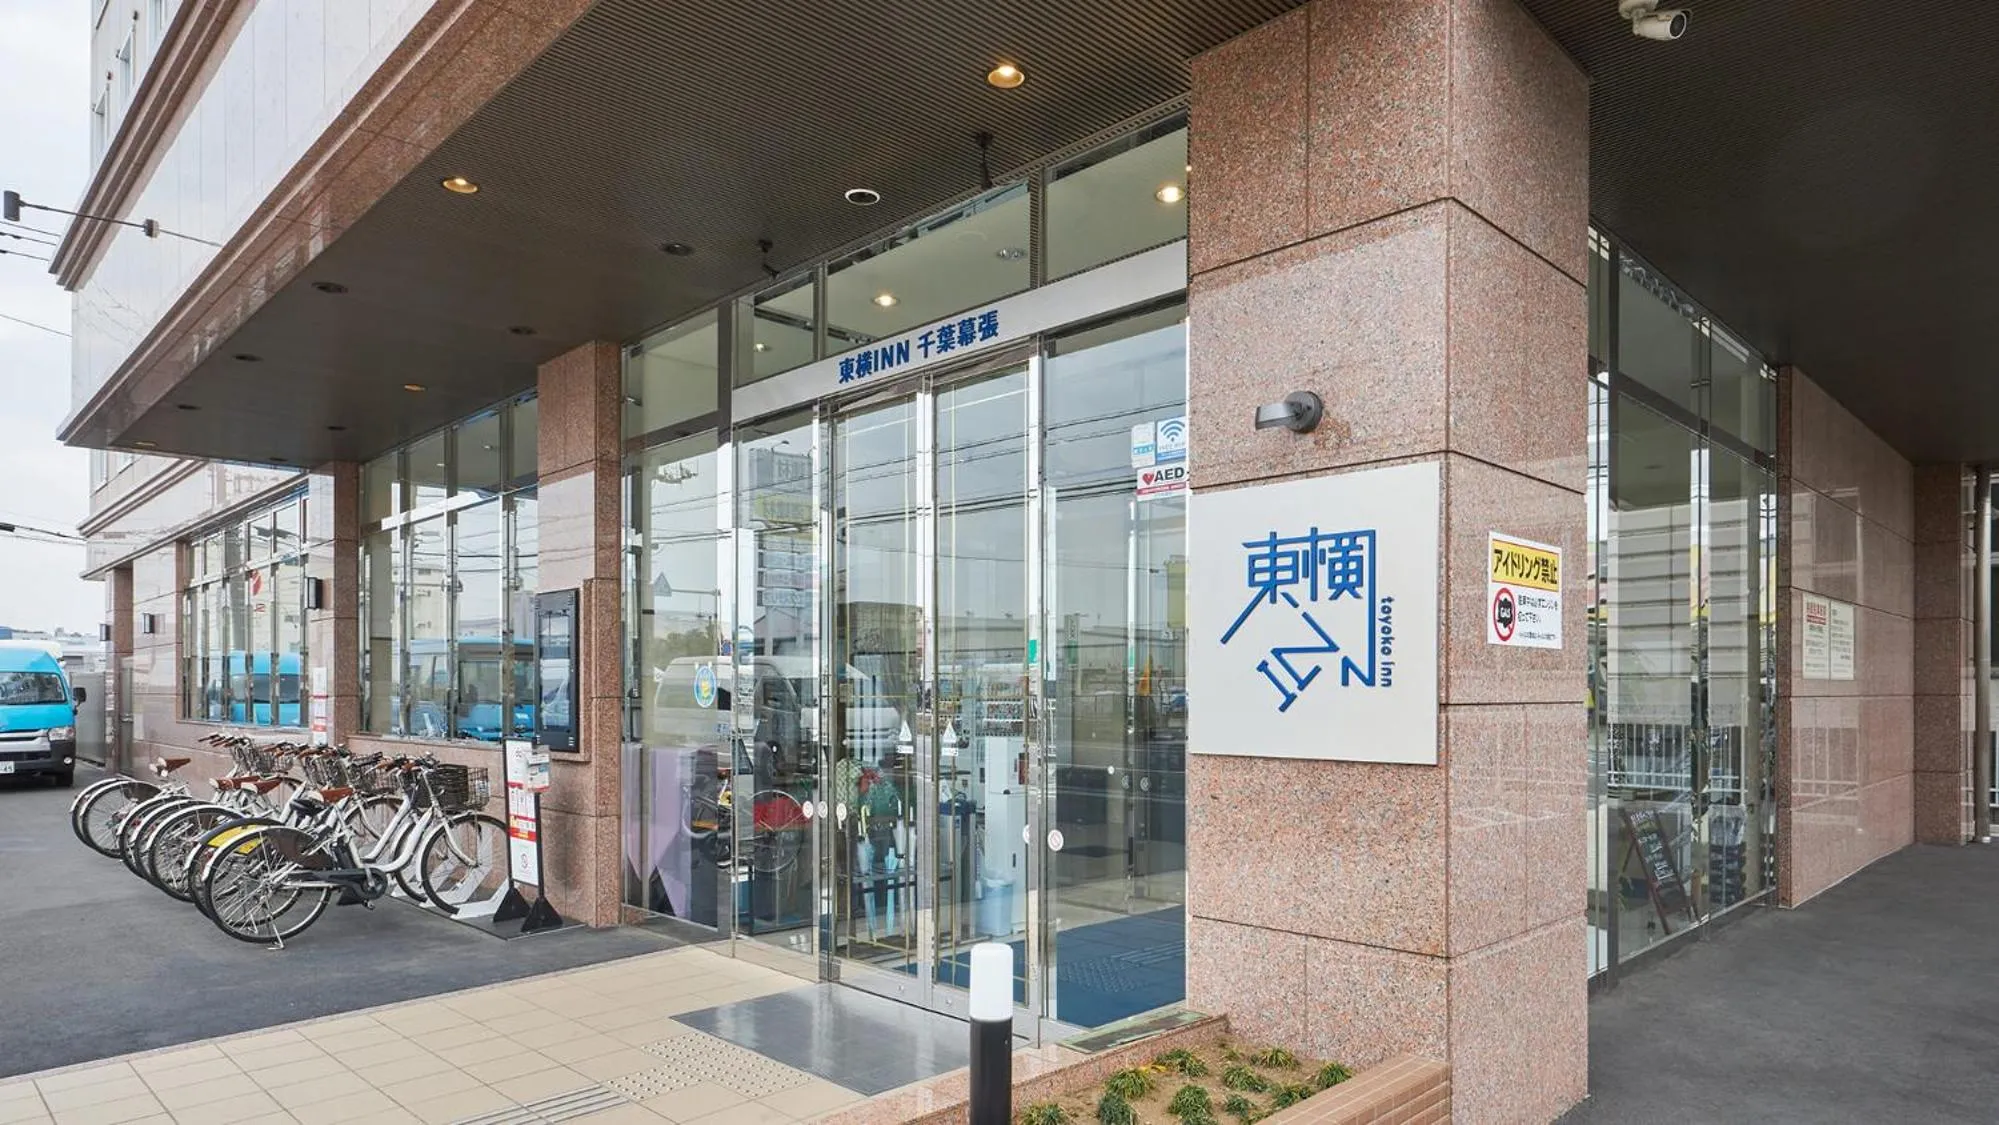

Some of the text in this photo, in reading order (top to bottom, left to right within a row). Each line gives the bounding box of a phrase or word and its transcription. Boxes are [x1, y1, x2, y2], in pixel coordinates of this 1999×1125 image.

[838, 310, 999, 384] 東横INN 千葉幕張
[1154, 467, 1185, 482] AED
[1493, 548, 1558, 585] アイドリング禁止
[1378, 596, 1395, 687] toyoko inn
